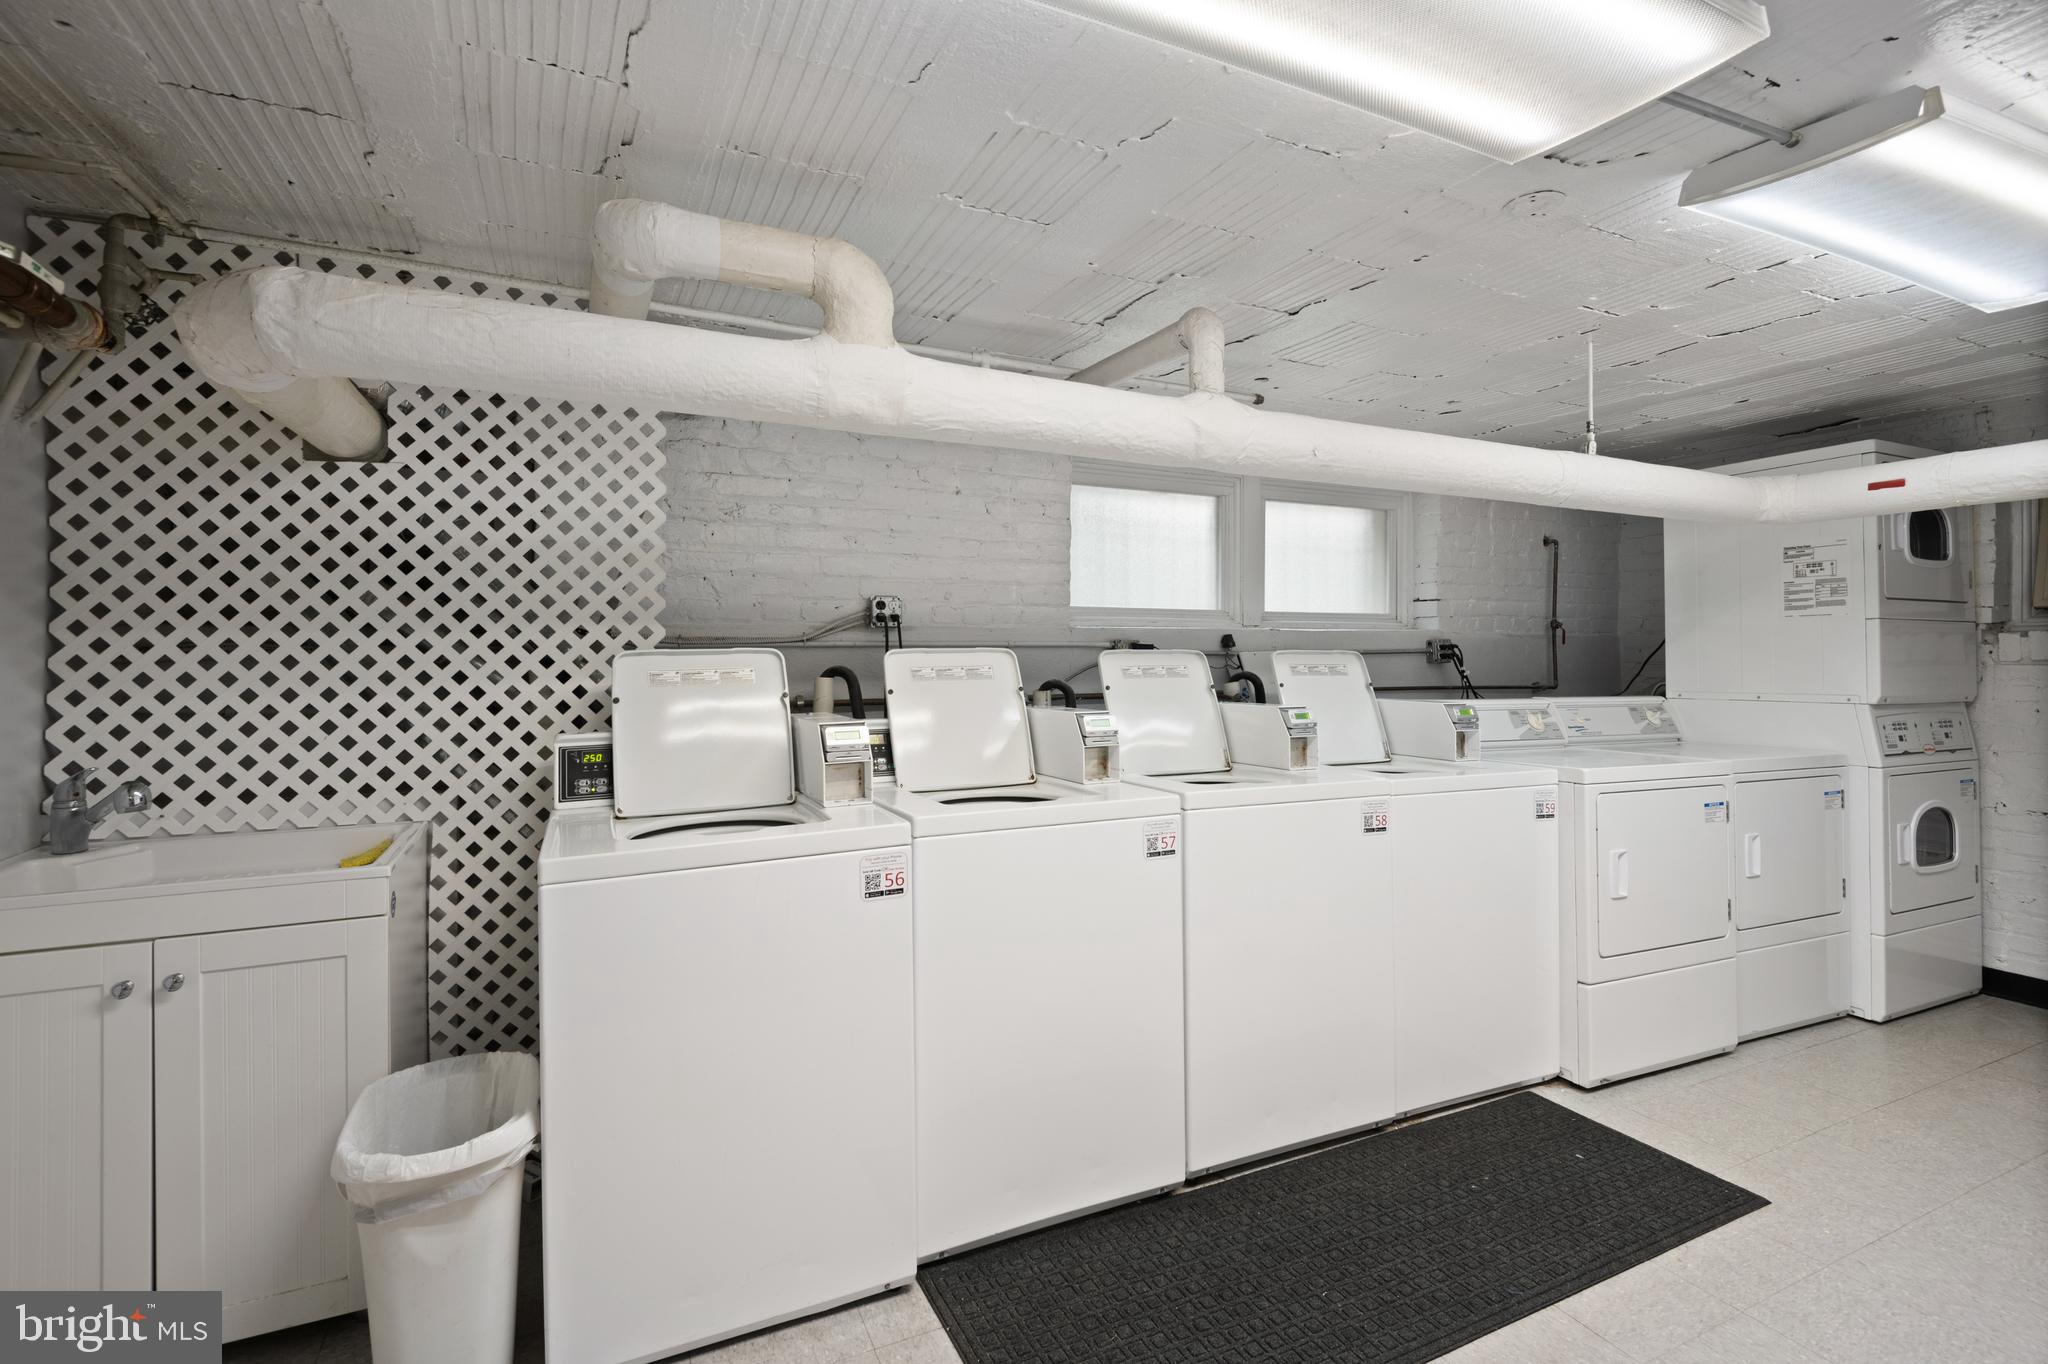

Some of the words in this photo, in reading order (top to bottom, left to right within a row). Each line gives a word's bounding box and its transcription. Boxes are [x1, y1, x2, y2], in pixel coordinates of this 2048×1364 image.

[583, 753, 603, 763] 250
[1545, 802, 1556, 813] 59
[1375, 814, 1388, 827] 58
[1161, 835, 1176, 849] 57
[884, 871, 905, 888] 56
